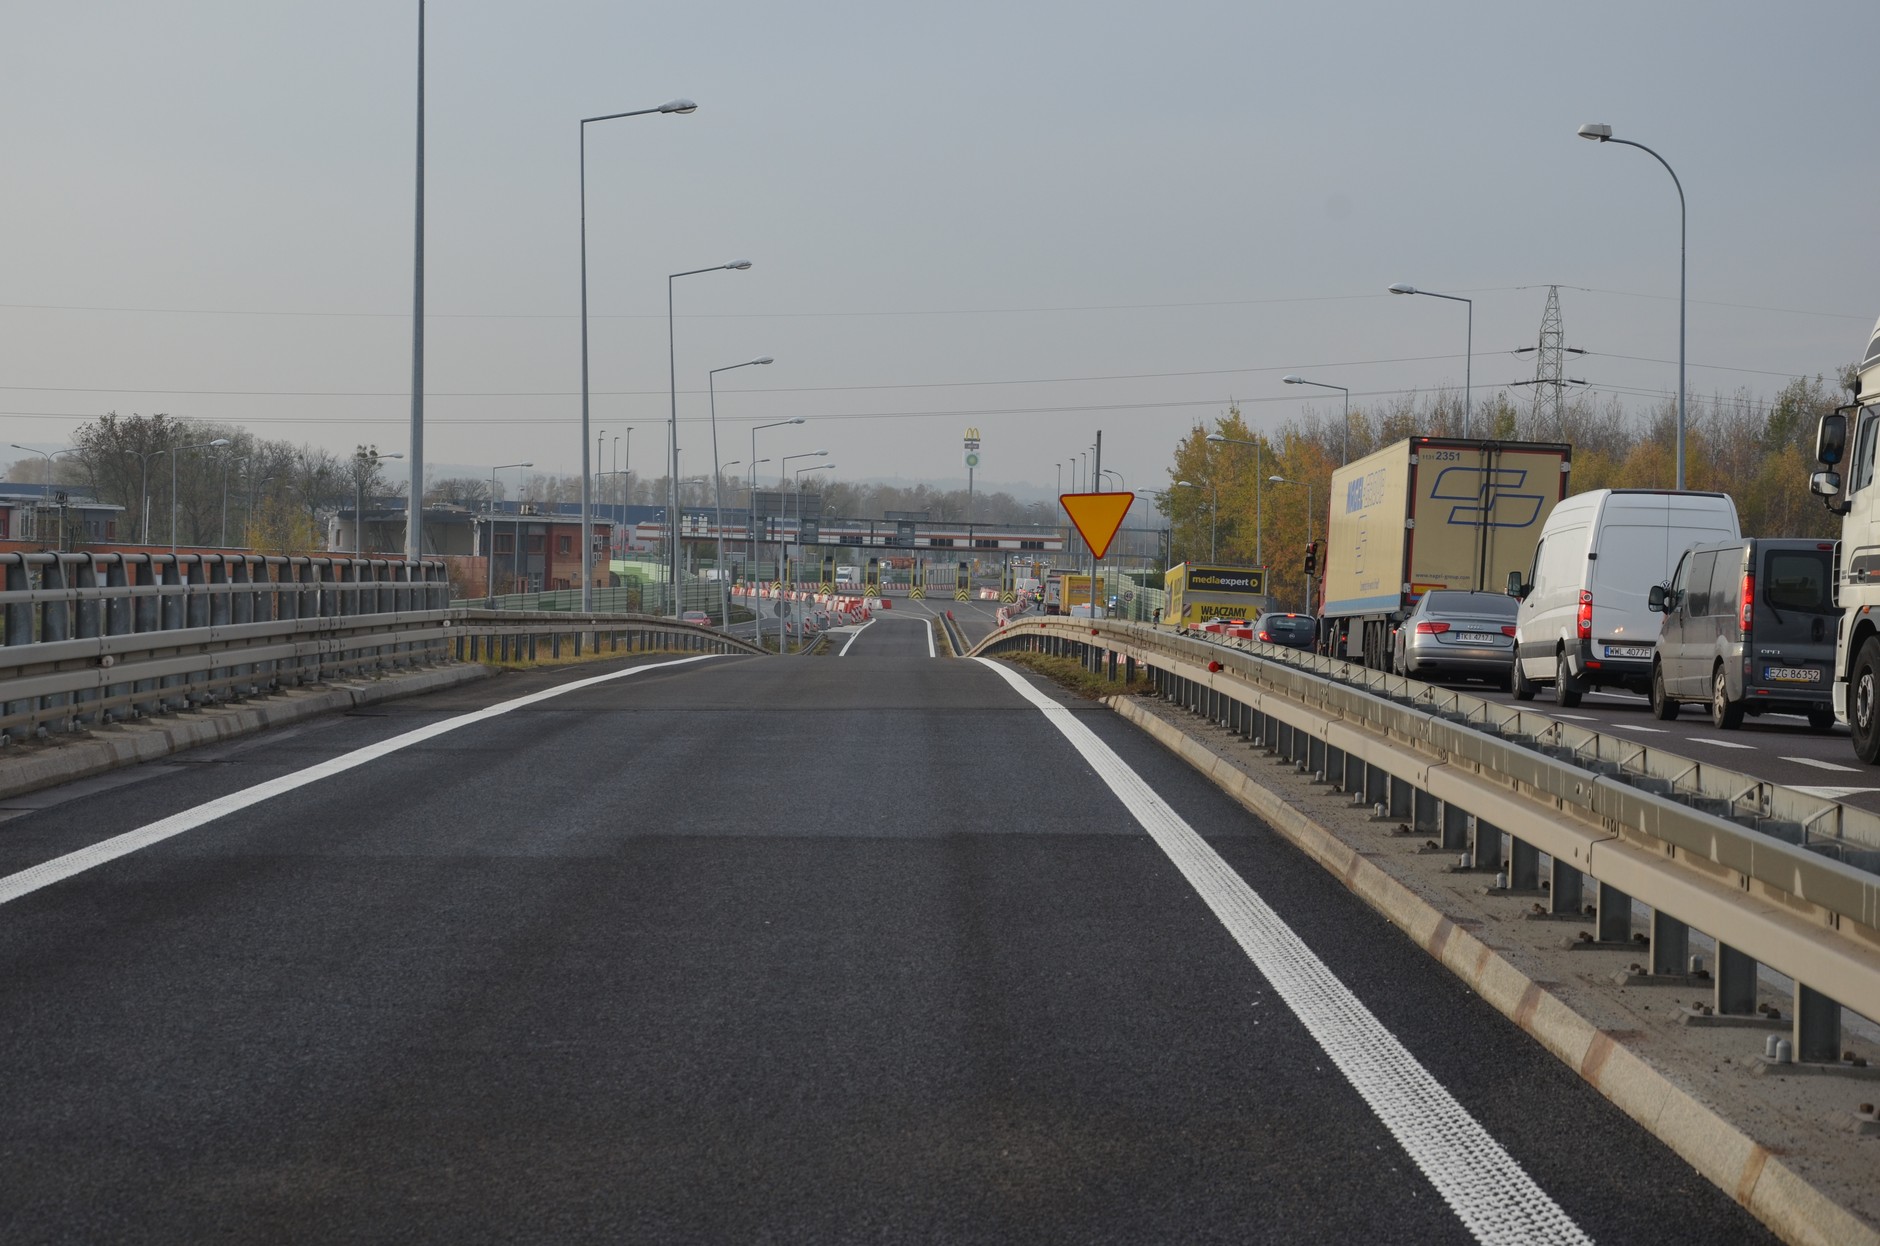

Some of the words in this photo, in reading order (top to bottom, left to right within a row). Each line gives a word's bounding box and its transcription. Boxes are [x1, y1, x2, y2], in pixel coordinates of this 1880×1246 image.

[1436, 451, 1460, 461] 2351
[1192, 575, 1249, 587] mediaexpert
[1201, 605, 1247, 617] WŁĄCZAMY
[1609, 647, 1623, 656] WWL
[1627, 648, 1649, 656] 4077F
[1770, 668, 1788, 678] EZG
[1791, 669, 1819, 679] 86352
